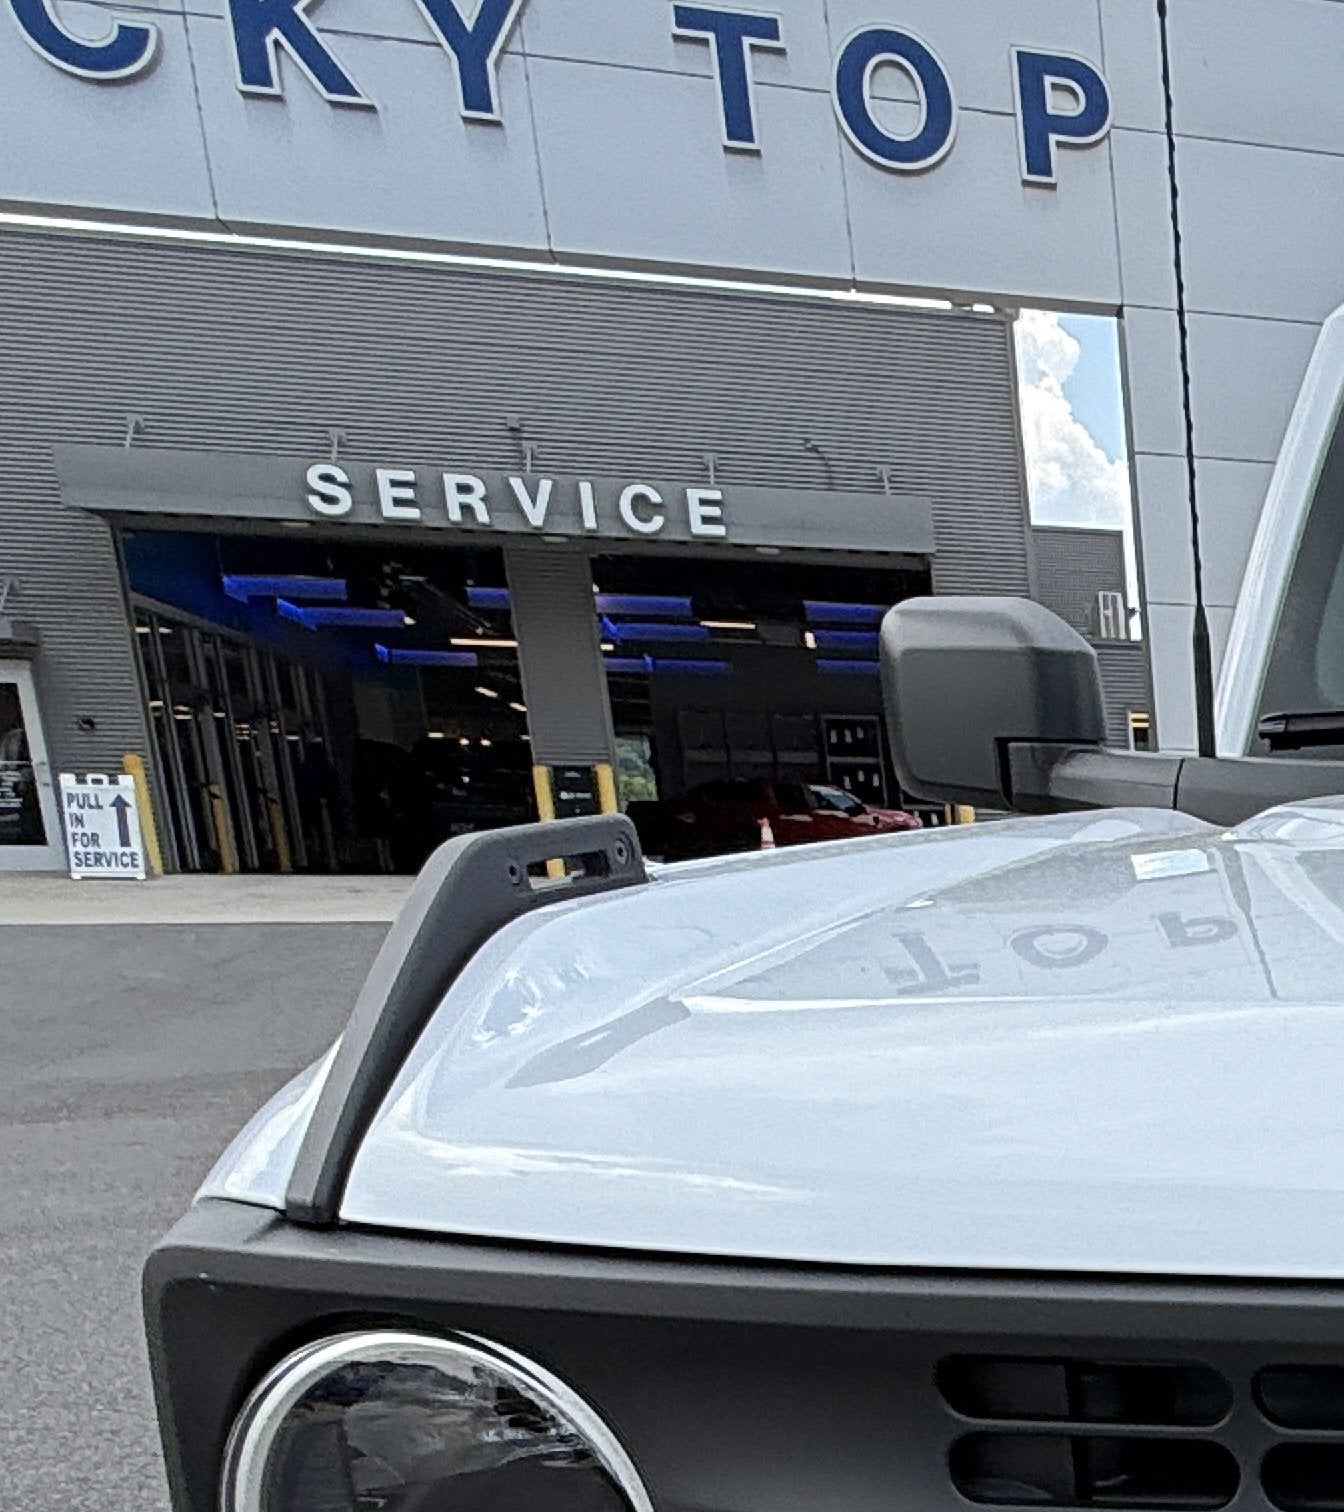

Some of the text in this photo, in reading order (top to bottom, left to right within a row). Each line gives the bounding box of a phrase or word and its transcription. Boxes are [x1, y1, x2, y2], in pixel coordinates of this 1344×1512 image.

[672, 4, 1114, 186] TOP
[305, 464, 728, 536] SERVICE
[66, 792, 104, 810] PULL
[69, 812, 85, 828] IN
[71, 832, 101, 849] FOR
[73, 851, 140, 868] SERVICE
